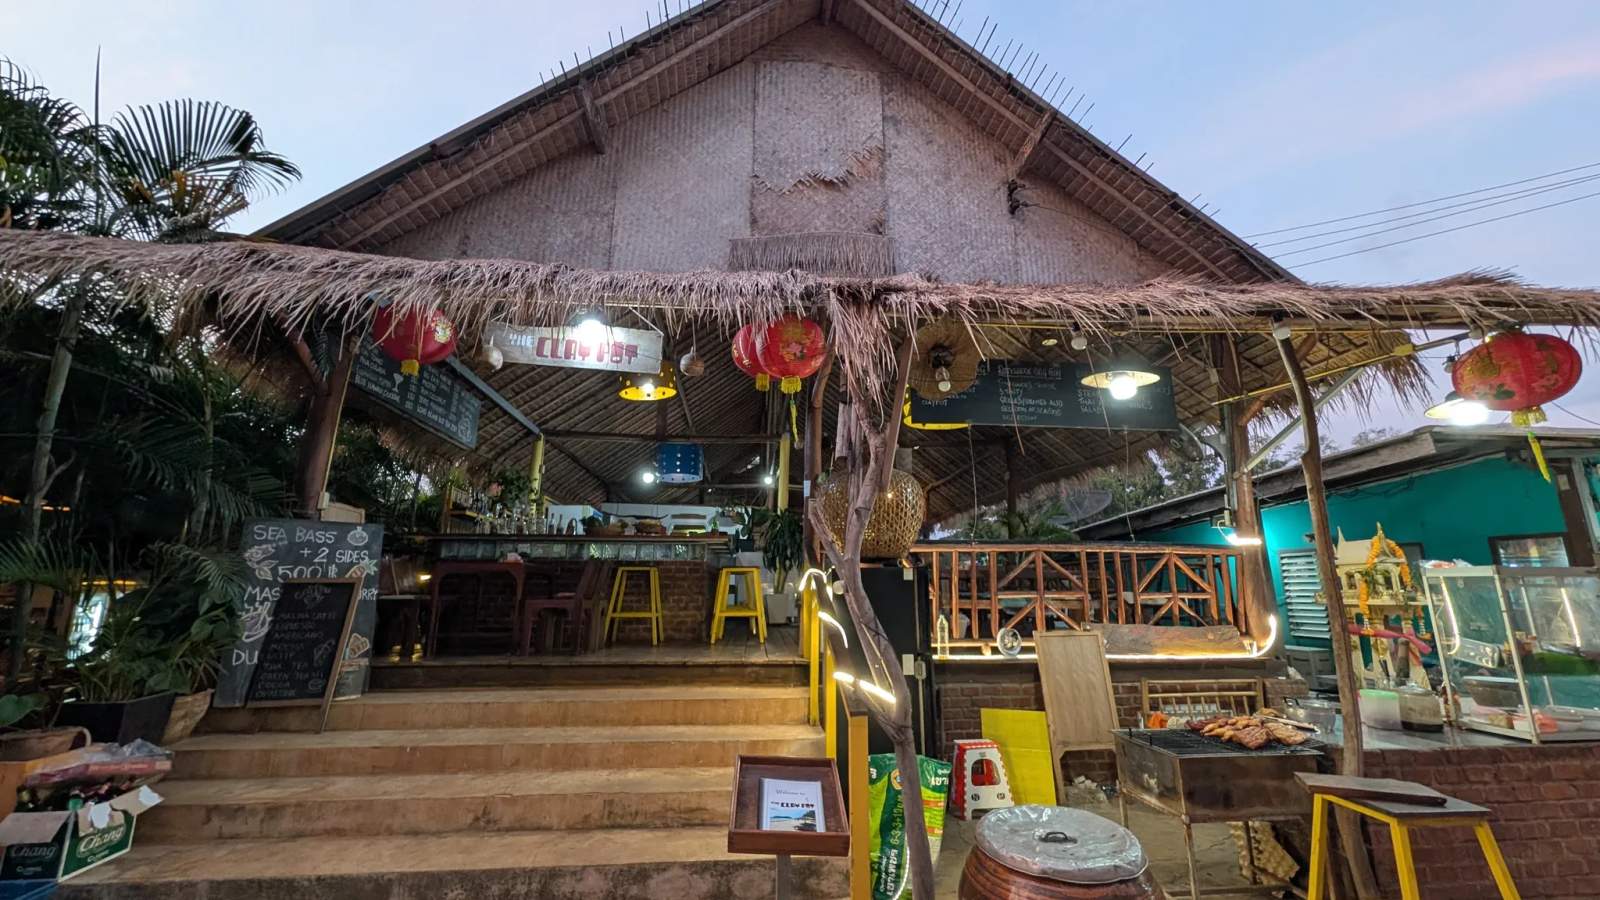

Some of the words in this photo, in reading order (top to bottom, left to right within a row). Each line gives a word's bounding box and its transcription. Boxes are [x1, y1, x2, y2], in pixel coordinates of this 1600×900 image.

[536, 336, 590, 361] CLAY
[253, 524, 288, 541] SEA
[295, 526, 338, 544] BASS
[335, 549, 369, 563] SIDES
[277, 564, 322, 582] 500
[79, 826, 124, 852] Chang
